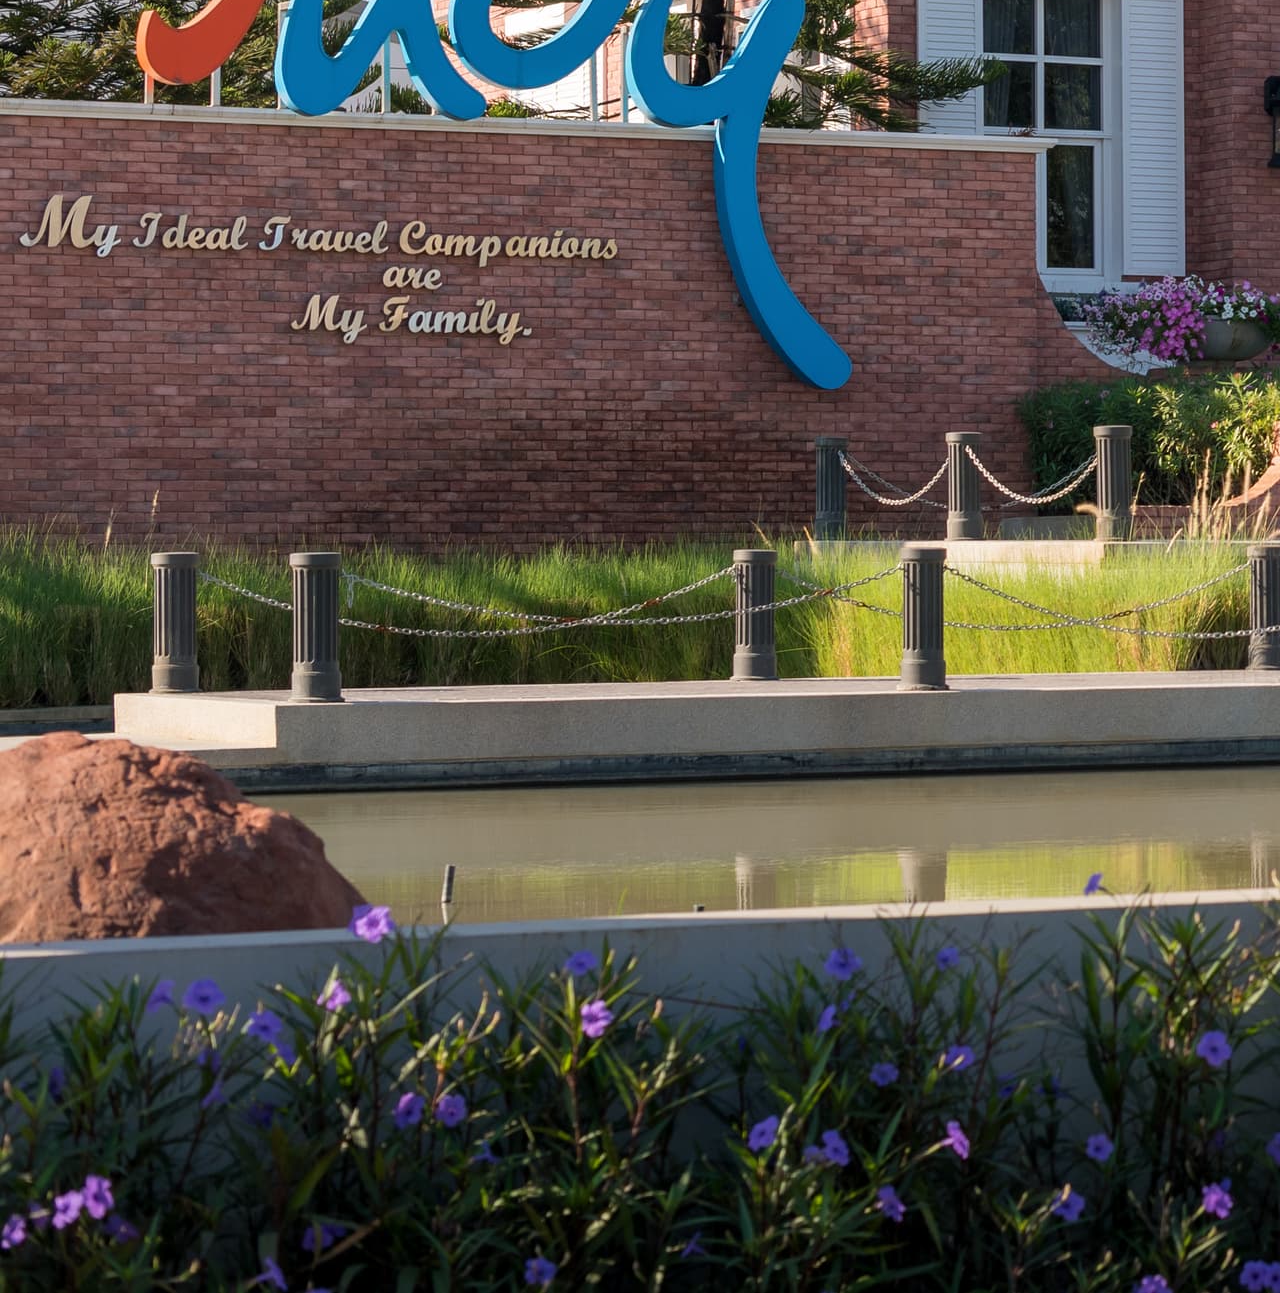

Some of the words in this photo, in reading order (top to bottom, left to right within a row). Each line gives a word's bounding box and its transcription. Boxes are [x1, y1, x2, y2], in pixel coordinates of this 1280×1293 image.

[19, 194, 121, 258] My
[132, 211, 248, 250] Ideal
[258, 215, 389, 254] Travel
[399, 220, 618, 268] Companions
[382, 265, 443, 291] are
[290, 293, 368, 345] My
[378, 294, 533, 346] Family.
